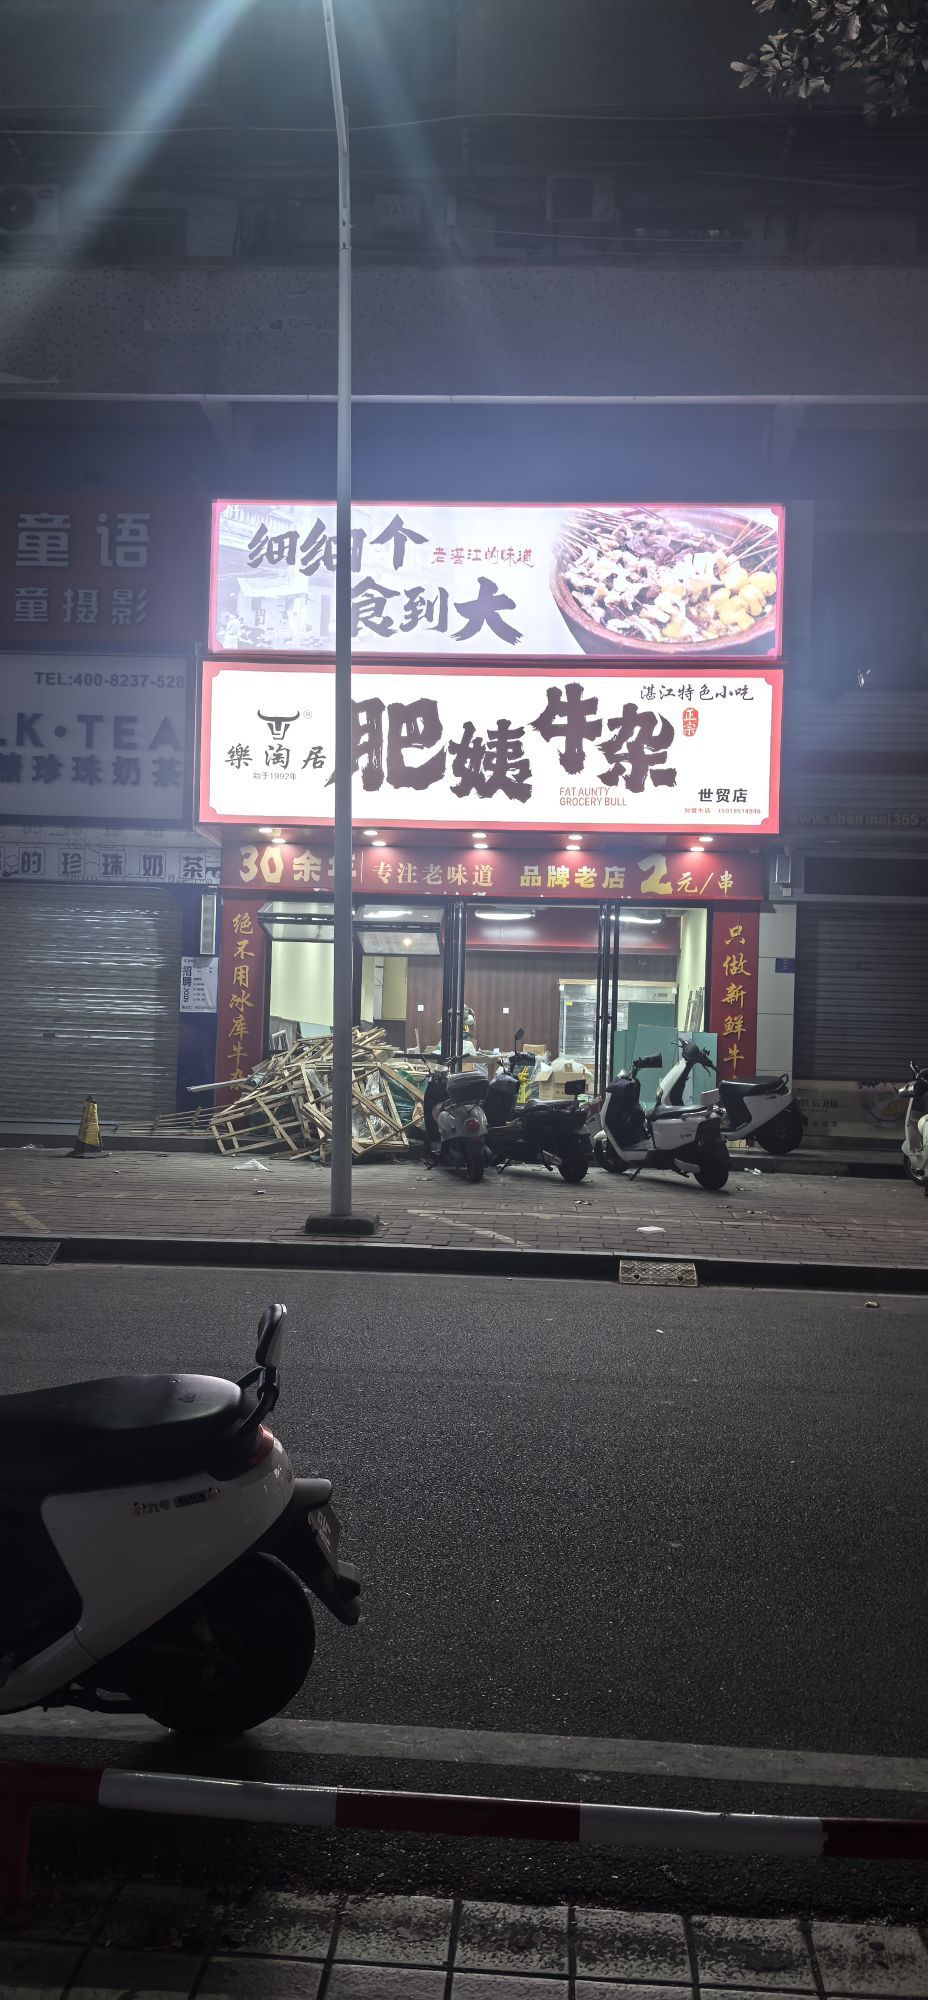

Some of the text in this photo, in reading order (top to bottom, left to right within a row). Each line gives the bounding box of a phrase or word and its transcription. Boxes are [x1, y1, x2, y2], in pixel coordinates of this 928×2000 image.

[16, 513, 151, 568] 童语
[247, 514, 429, 577] 细细个
[431, 546, 534, 568] 老湛江的味道
[15, 587, 148, 625] 童摄影
[351, 576, 524, 646] 食到大
[641, 684, 754, 702] 湛江特色小吃
[683, 708, 699, 737] 正宗
[225, 743, 327, 770] 樂淘居
[324, 682, 677, 804] 肥姨牛杂
[253, 772, 296, 781] 始于1992年
[560, 787, 610, 797] FAT AUNTY
[560, 797, 627, 807] GROCERY BULL
[698, 788, 748, 803] 世贸店
[0, 851, 204, 879] 的珍珠奶茶
[370, 861, 494, 887] 专注老味道
[520, 865, 626, 889] 品牌老店
[721, 925, 752, 1079] 只做新鲜牛
